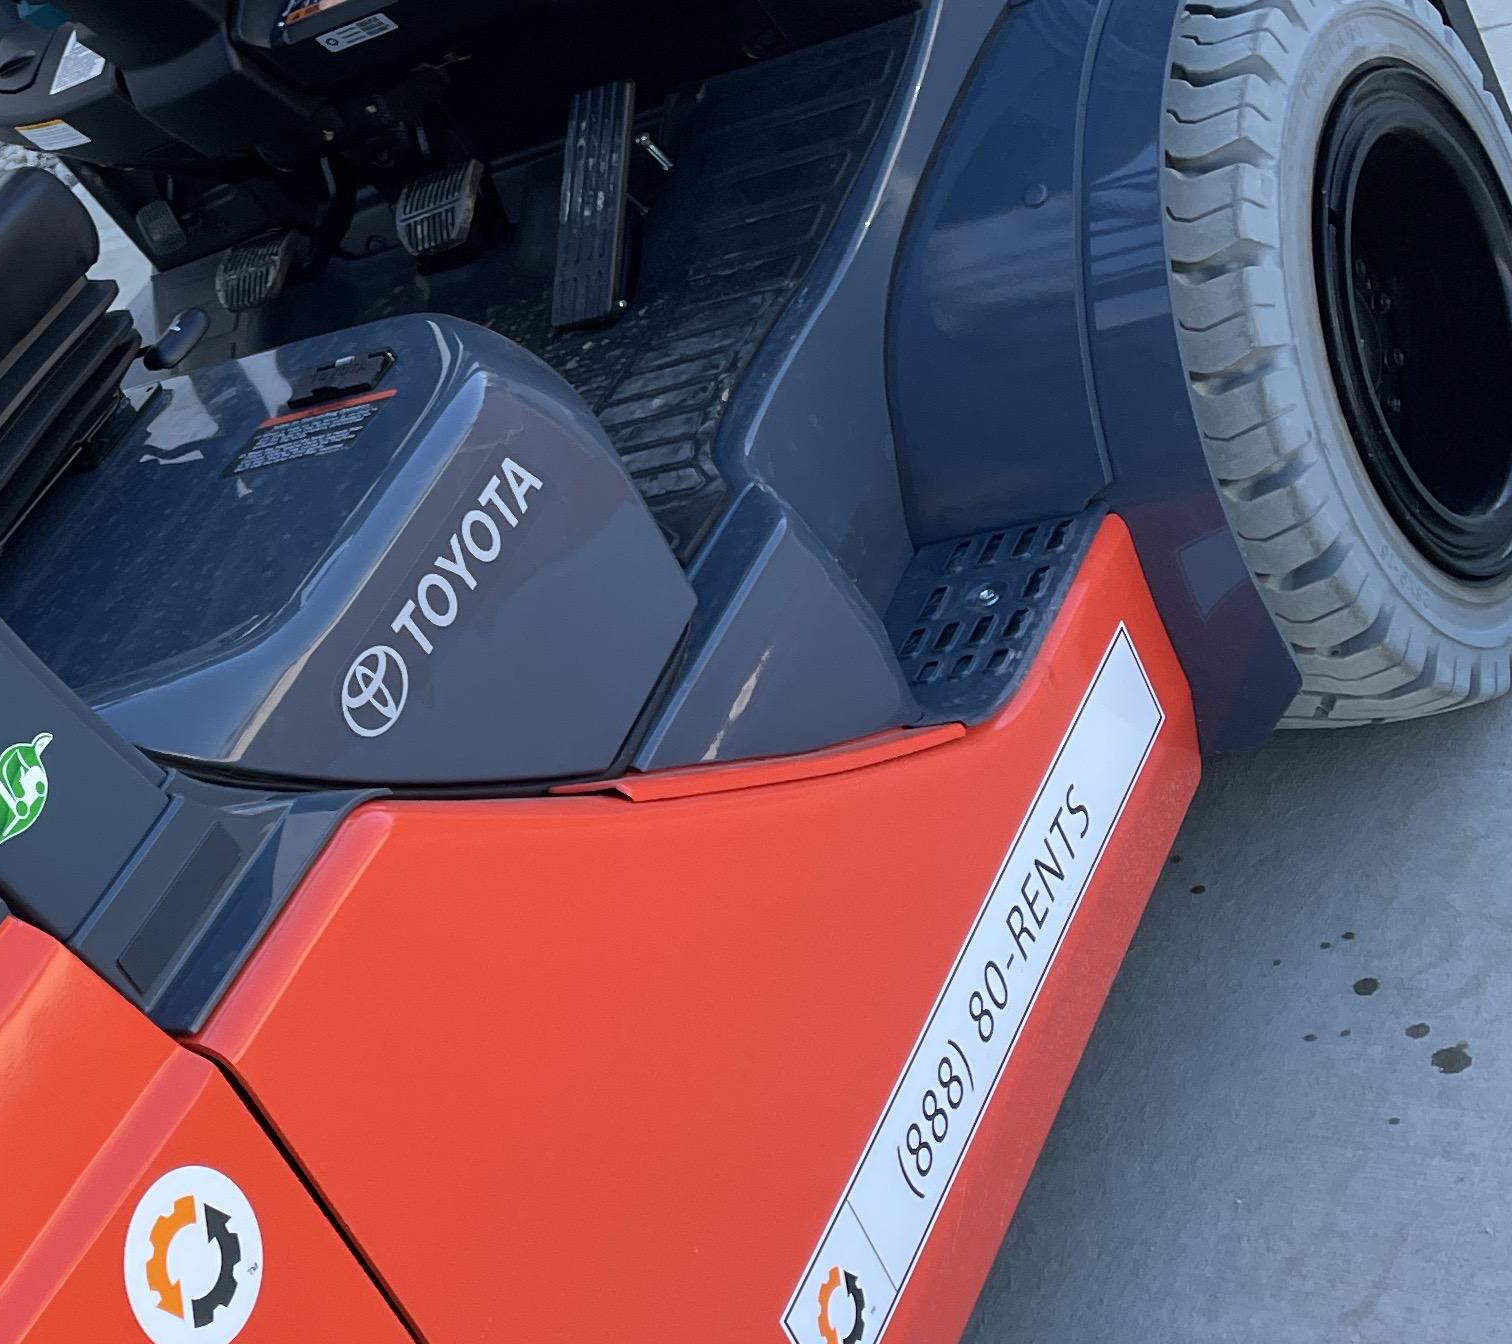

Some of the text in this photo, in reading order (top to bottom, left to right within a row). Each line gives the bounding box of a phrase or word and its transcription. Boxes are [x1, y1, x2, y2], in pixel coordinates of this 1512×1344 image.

[391, 457, 544, 655] TOYOTA
[897, 783, 1091, 1199] (888) 80-RENTS
